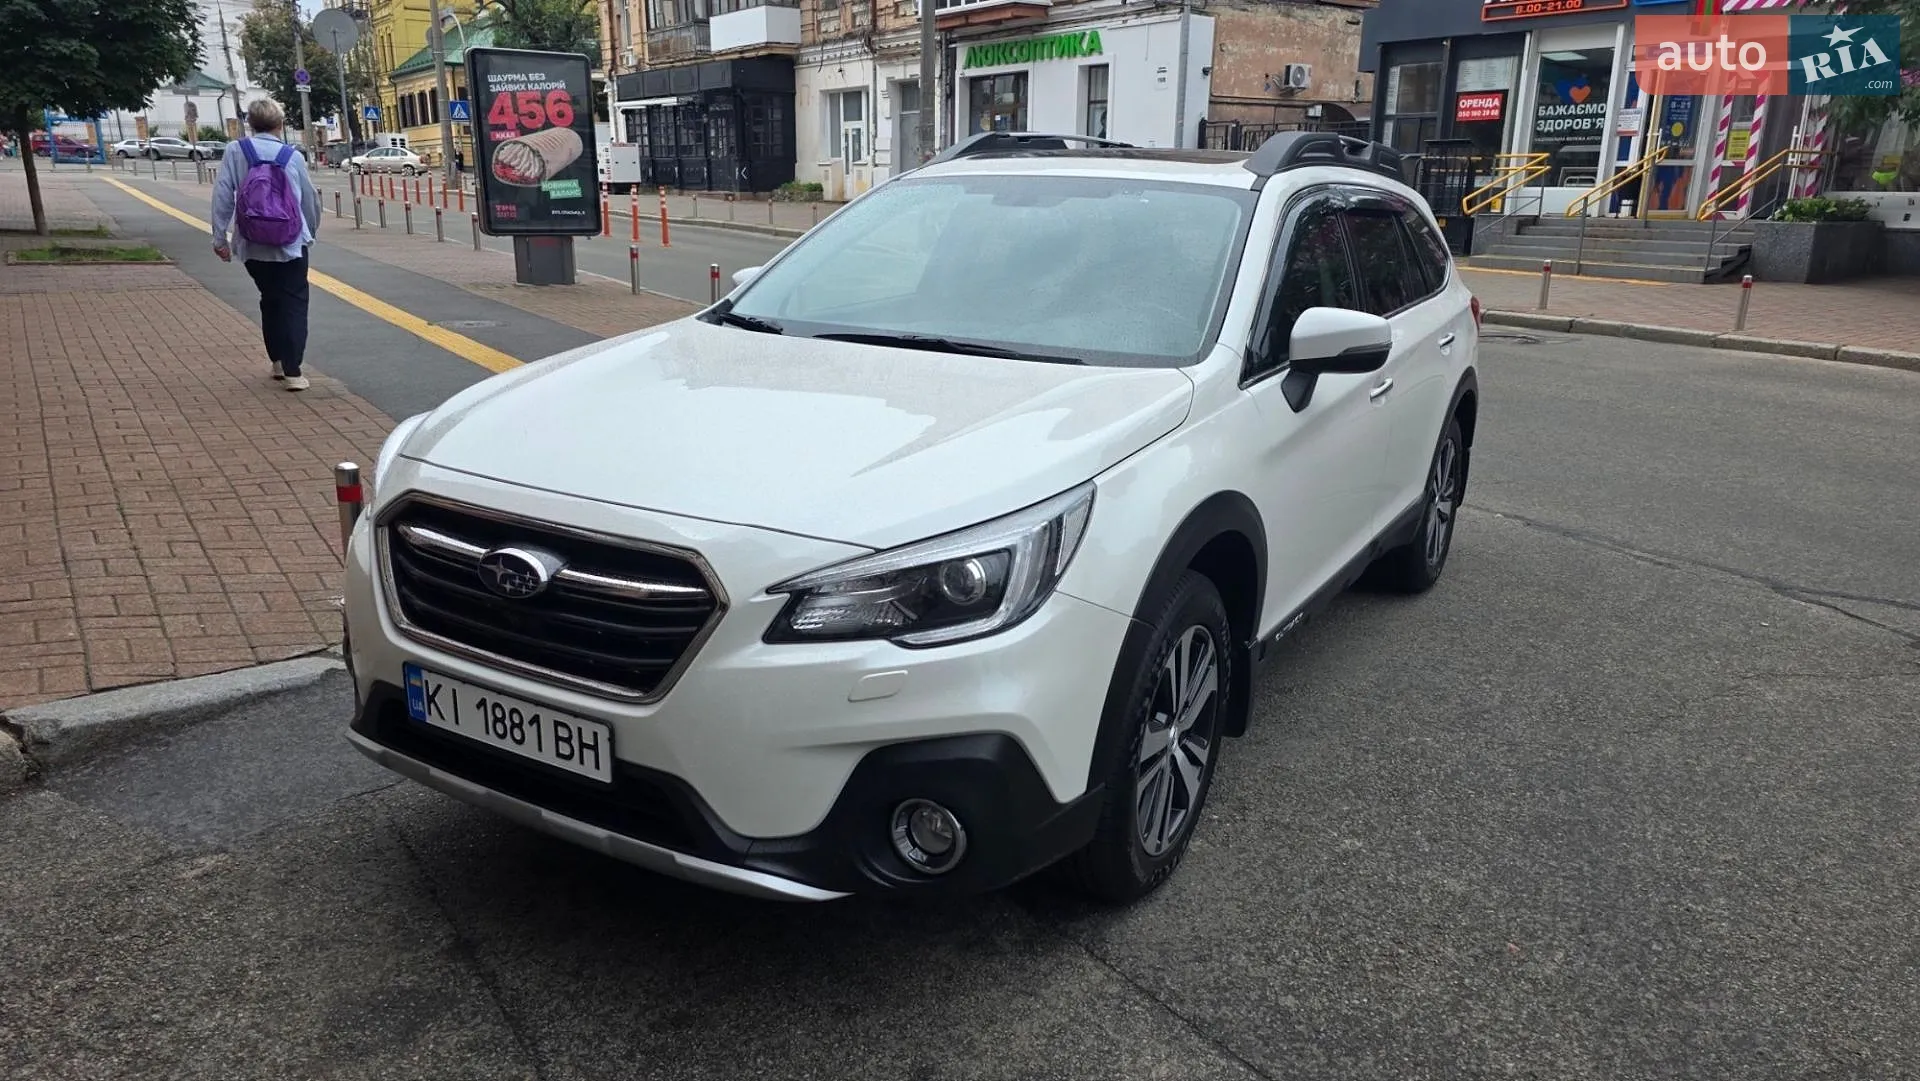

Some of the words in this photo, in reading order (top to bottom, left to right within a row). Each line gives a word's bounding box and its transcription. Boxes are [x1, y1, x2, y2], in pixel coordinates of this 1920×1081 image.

[964, 30, 1103, 69] ЛЮКСОПТИКА
[487, 73, 528, 82] ШАУРМА
[528, 73, 546, 81] БЕЗ
[489, 82, 526, 92] ЗАЙВИХ
[527, 80, 566, 90] КАЛОРІЙ
[487, 89, 574, 130] 456
[1459, 97, 1500, 109] ОРЕНДА
[1537, 103, 1607, 116] БАЖАЄМО
[1536, 118, 1605, 132] ЗДОРОВ'Я
[412, 696, 424, 713] UA
[476, 697, 543, 752] 1881
